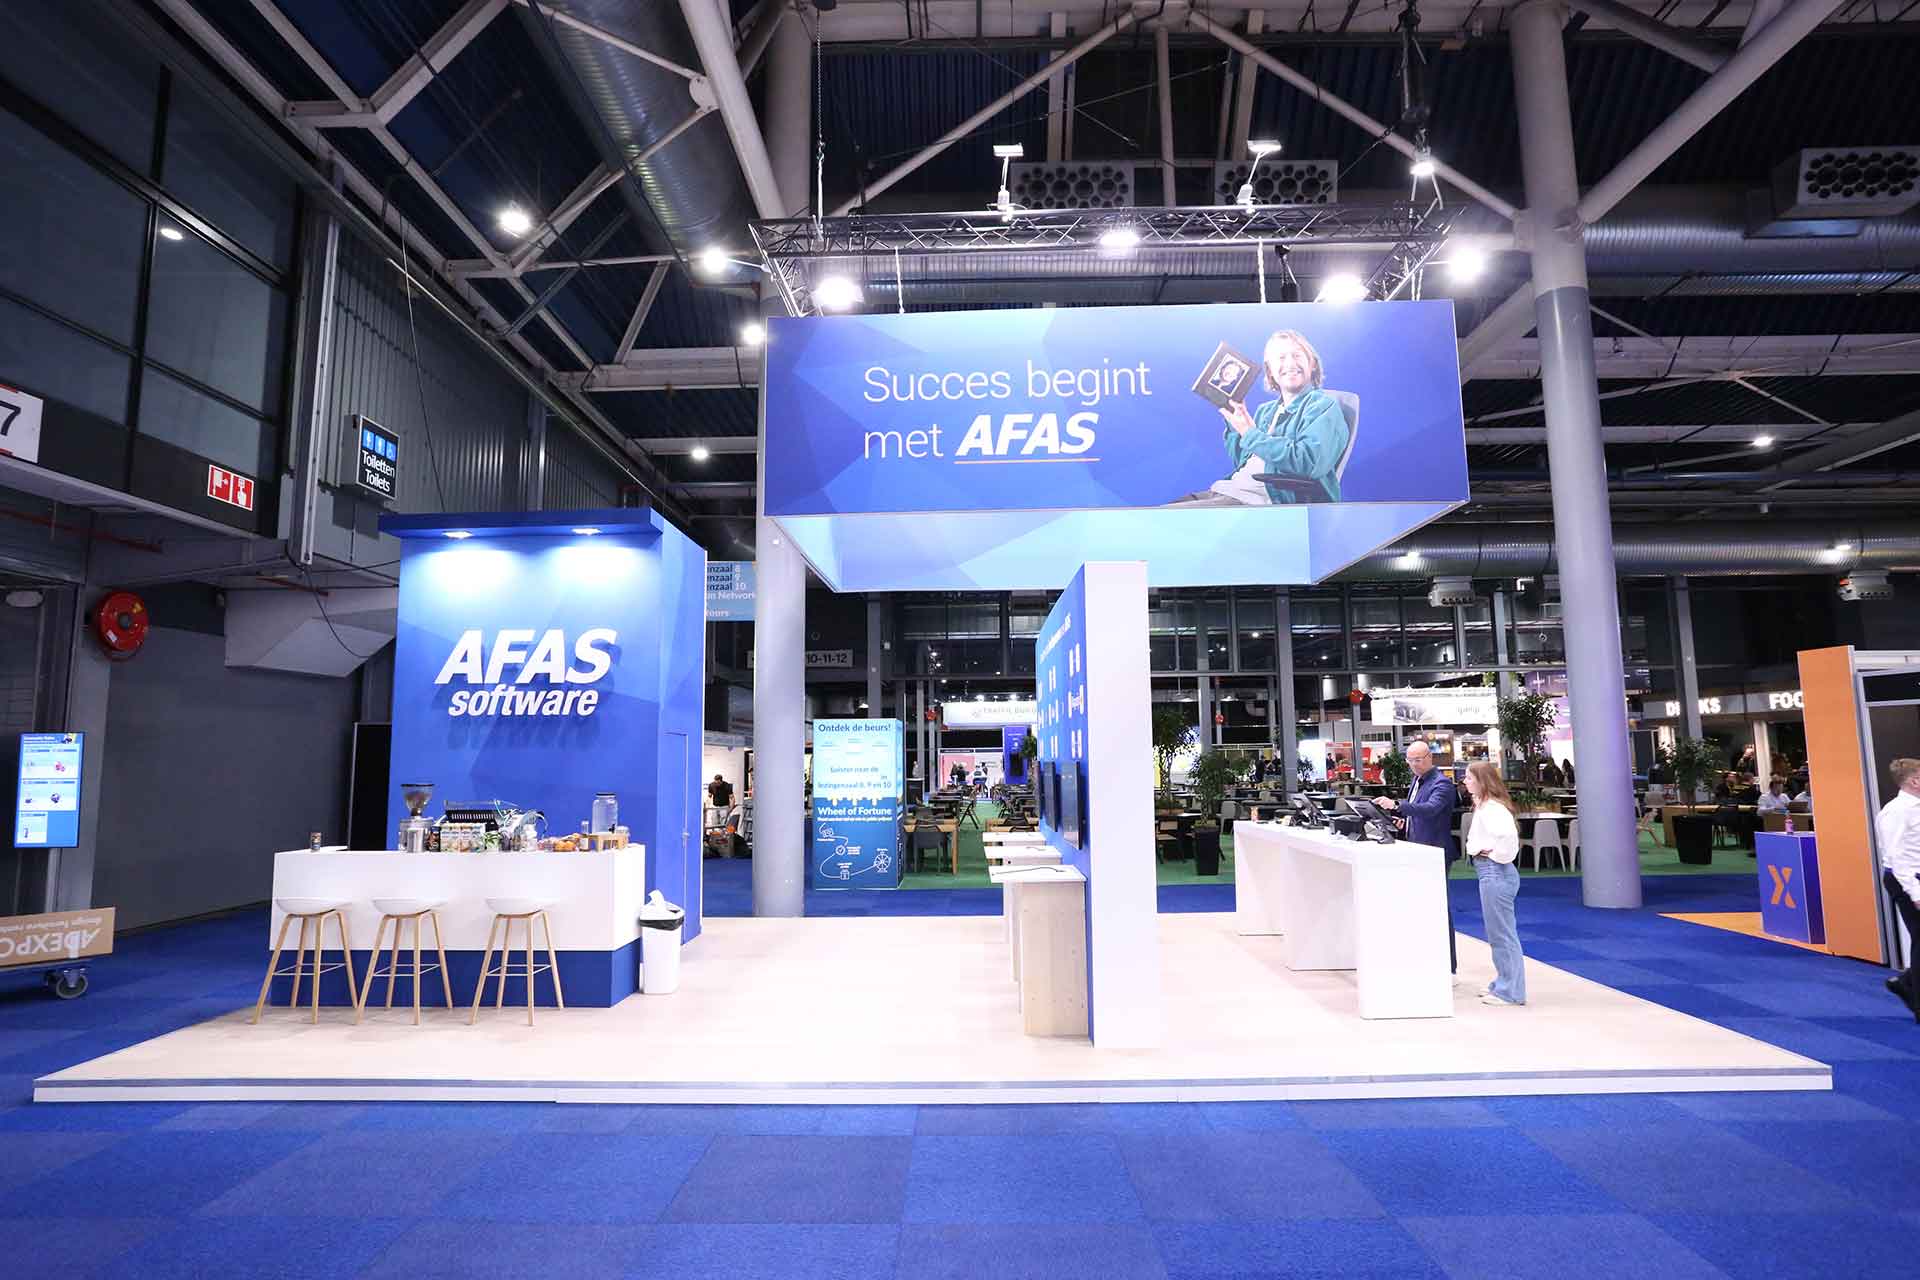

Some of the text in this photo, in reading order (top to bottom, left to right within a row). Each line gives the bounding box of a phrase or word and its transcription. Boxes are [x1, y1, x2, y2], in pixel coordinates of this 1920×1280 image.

[863, 358, 1153, 407] Succes begint
[863, 411, 1099, 459] met AFAS
[362, 450, 395, 478] Toiletten
[365, 469, 391, 492] Toilets
[434, 627, 617, 685] AFAS
[448, 683, 599, 717] software
[818, 723, 891, 732] Ontdek de beurs!
[817, 806, 892, 816] Wheel of Fortune
